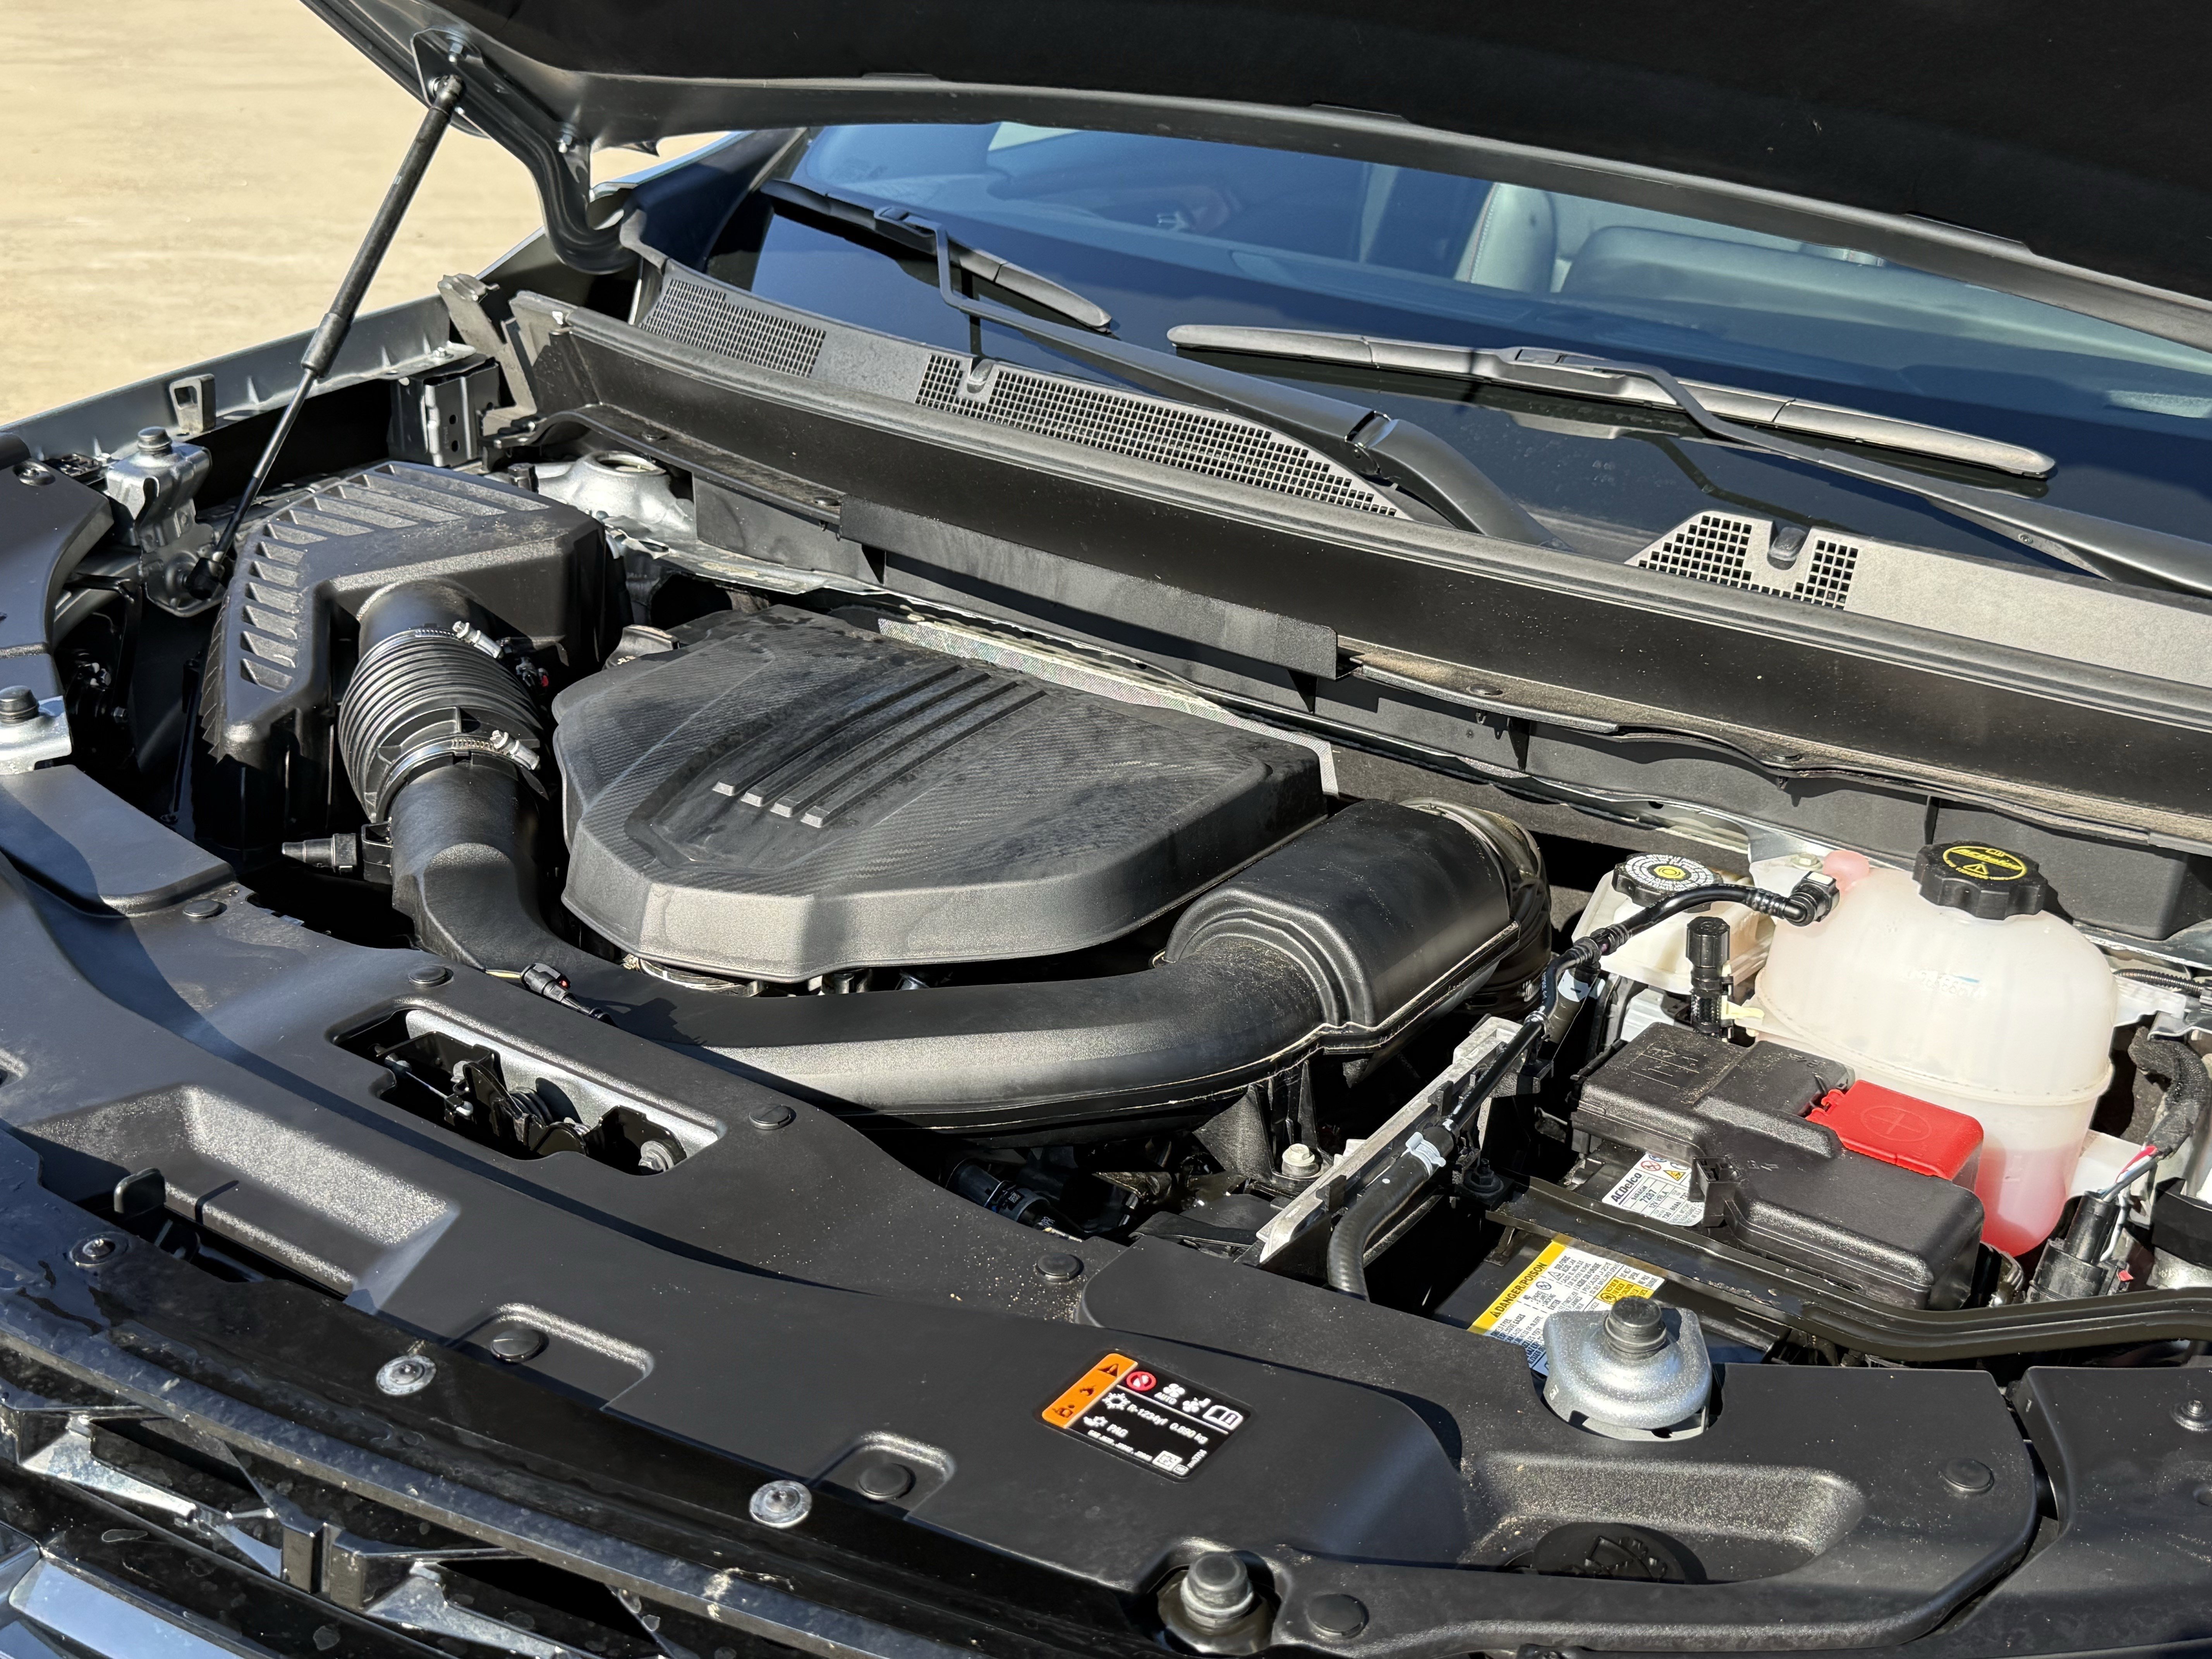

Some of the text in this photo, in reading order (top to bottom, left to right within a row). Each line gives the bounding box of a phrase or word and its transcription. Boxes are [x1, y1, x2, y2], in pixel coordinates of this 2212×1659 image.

[1611, 1173, 1642, 1202] ACDelco
[1495, 1262, 1547, 1312] DANGER/POISON
[1107, 1424, 1128, 1438] PAG
[1194, 1433, 1208, 1445] kg
